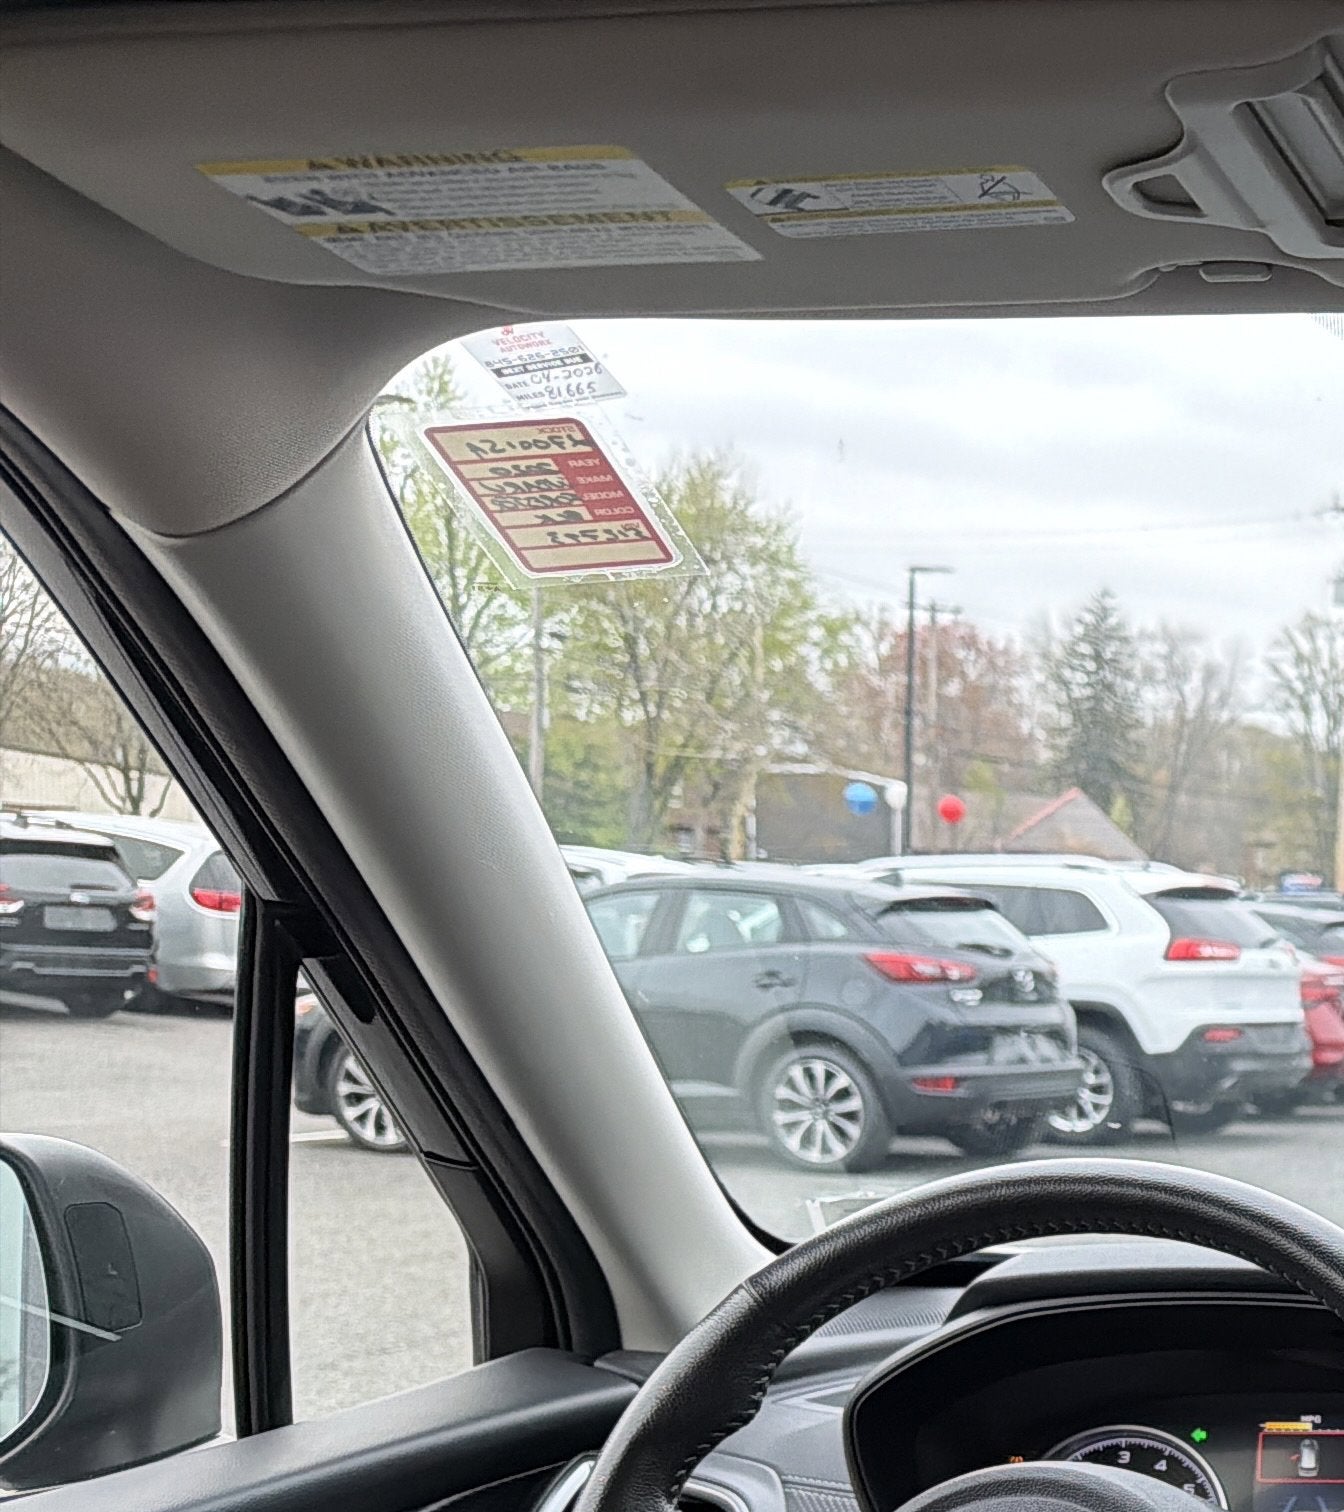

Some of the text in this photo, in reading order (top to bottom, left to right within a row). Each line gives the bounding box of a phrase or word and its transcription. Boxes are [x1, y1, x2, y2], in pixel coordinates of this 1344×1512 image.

[1116, 1450, 1131, 1464] 3
[1153, 1459, 1168, 1472] 4
[1183, 1483, 1196, 1496] 5
